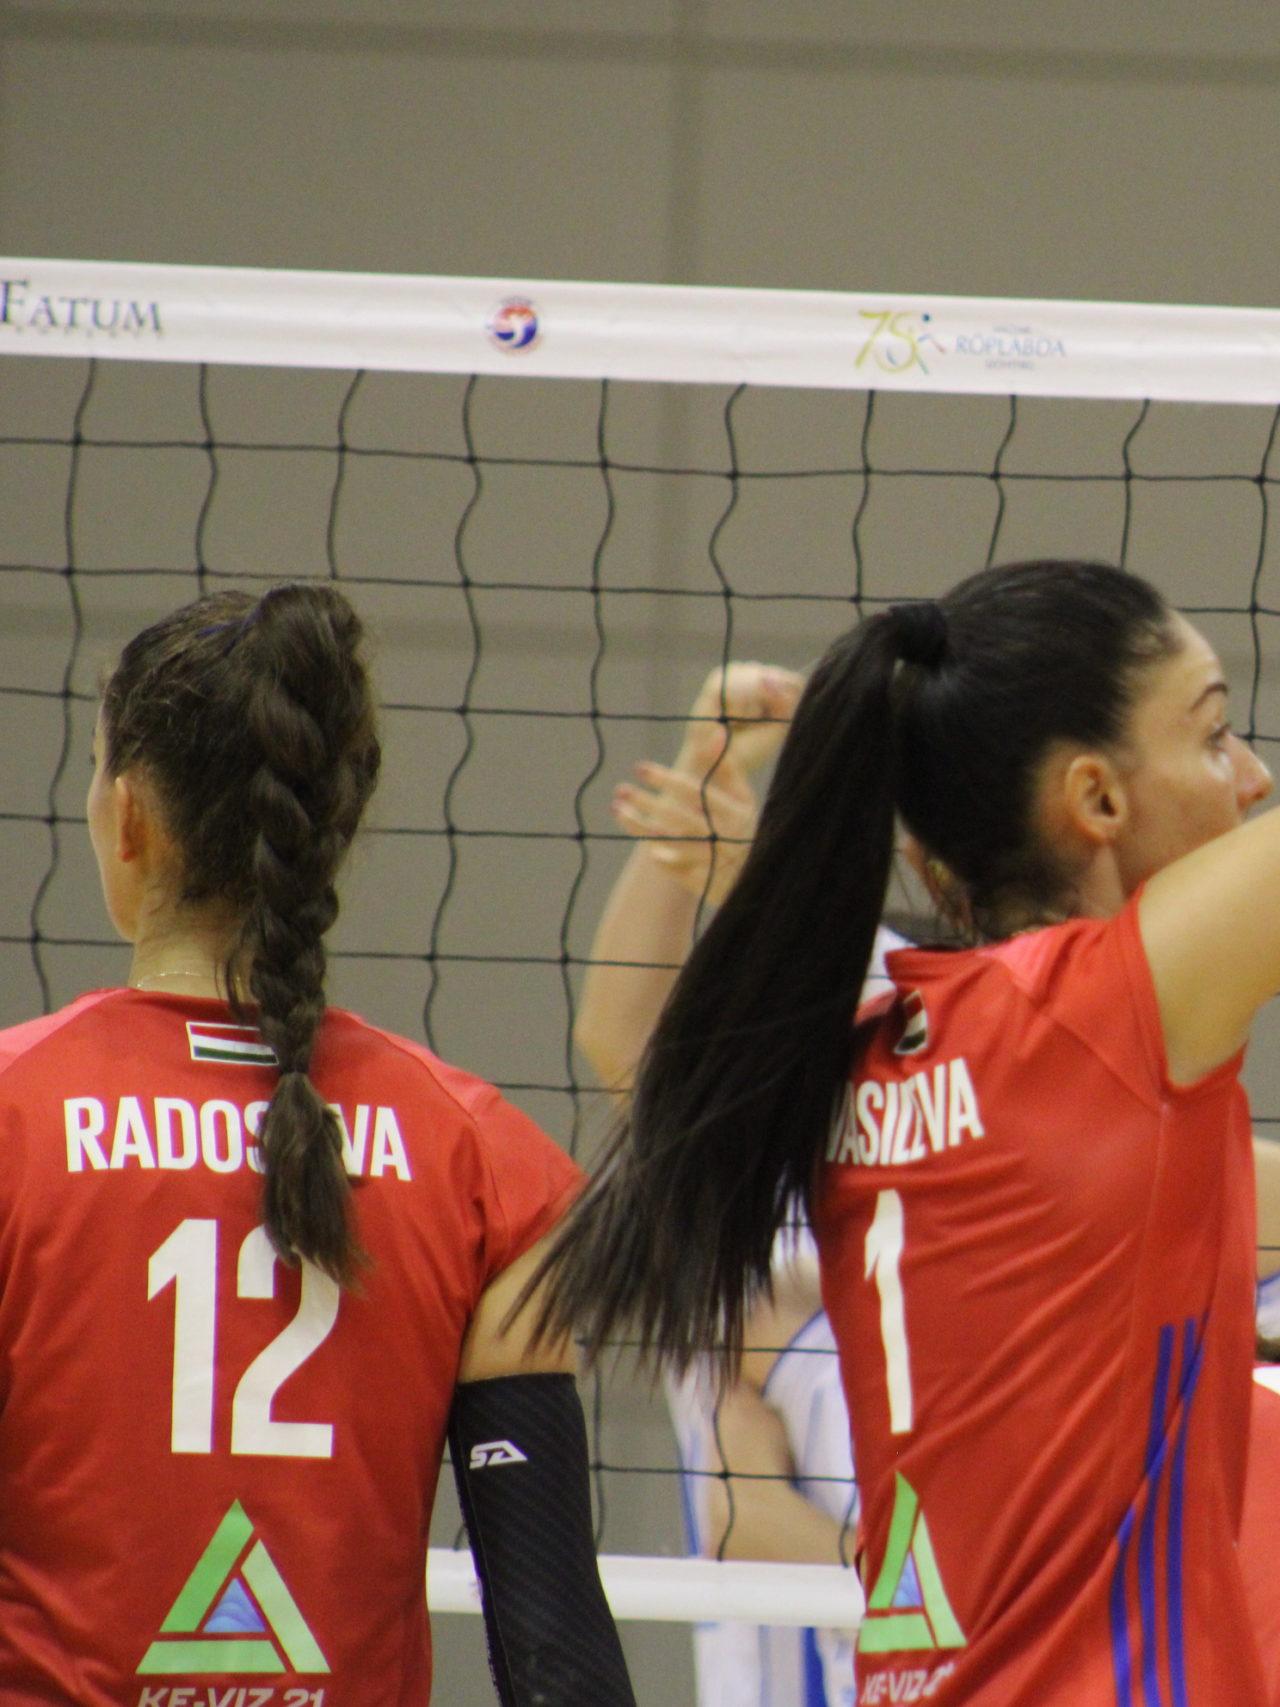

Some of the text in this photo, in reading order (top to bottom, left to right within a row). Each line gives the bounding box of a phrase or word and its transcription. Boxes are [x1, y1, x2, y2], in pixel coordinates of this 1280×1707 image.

[0, 279, 163, 332] FATUM
[63, 1096, 412, 1182] RADOSVA
[147, 1218, 340, 1459] 12
[864, 1188, 913, 1435] 1
